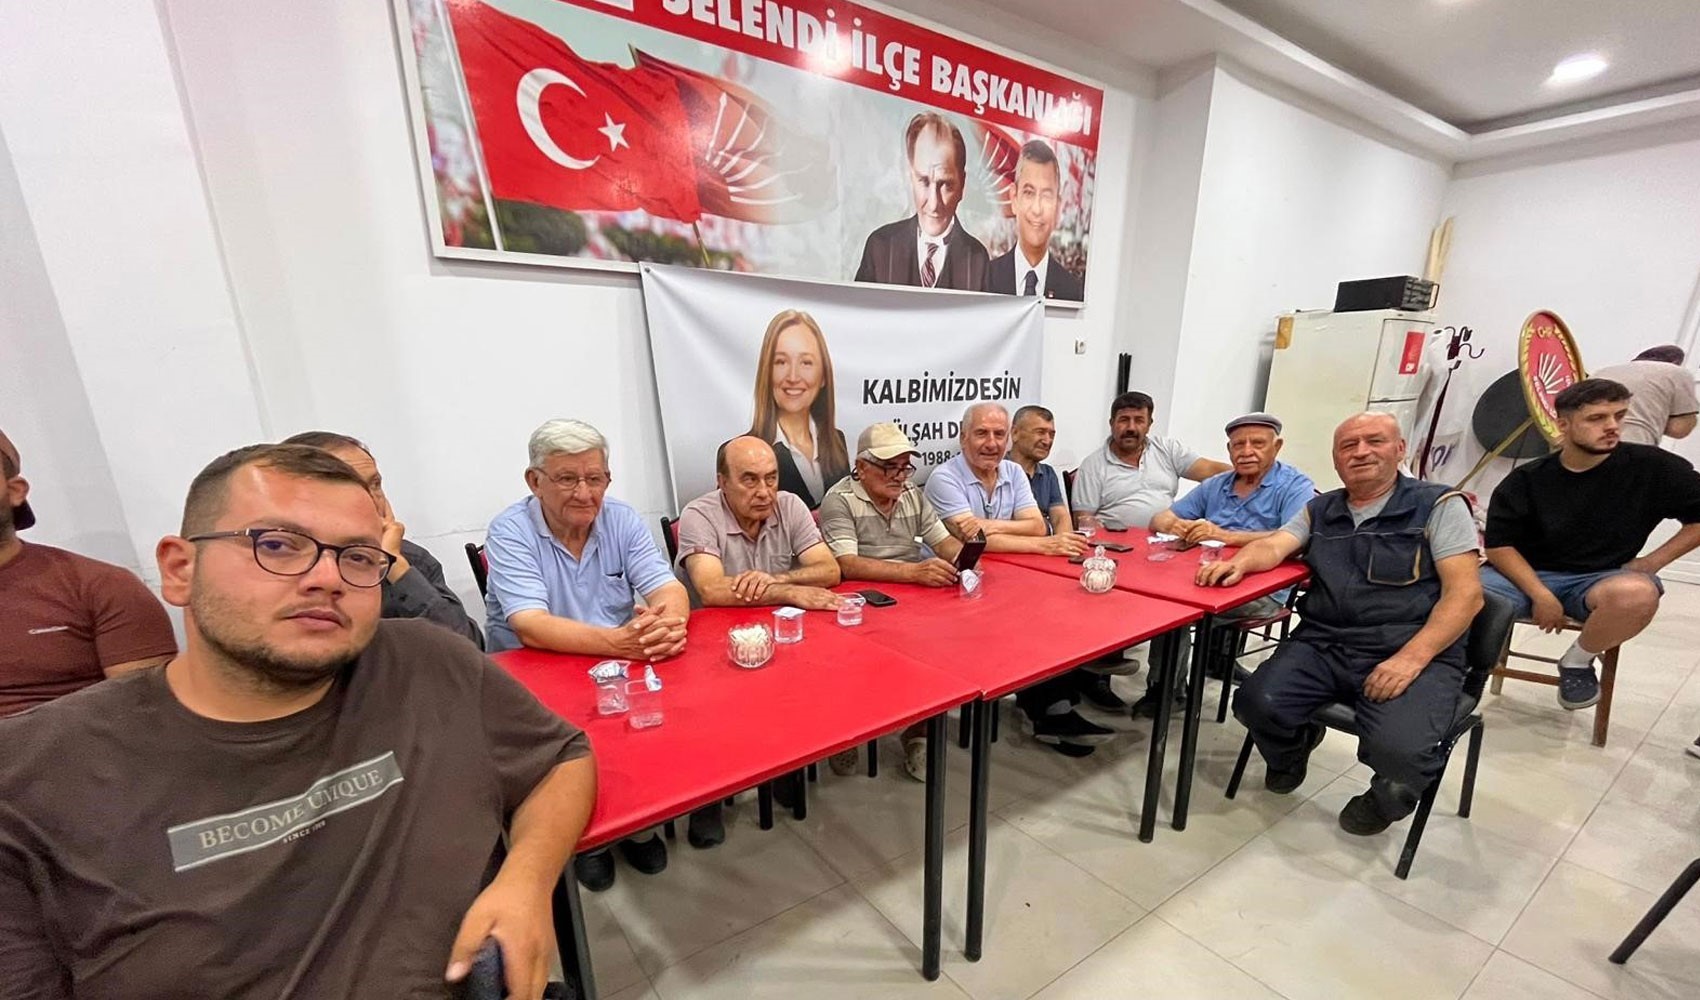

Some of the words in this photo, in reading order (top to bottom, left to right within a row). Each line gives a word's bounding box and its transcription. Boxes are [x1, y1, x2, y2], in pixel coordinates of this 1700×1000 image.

[852, 17, 921, 91] İLÇE
[863, 370, 1021, 404] KALBİMİZDESİN
[200, 803, 304, 849] BECOME
